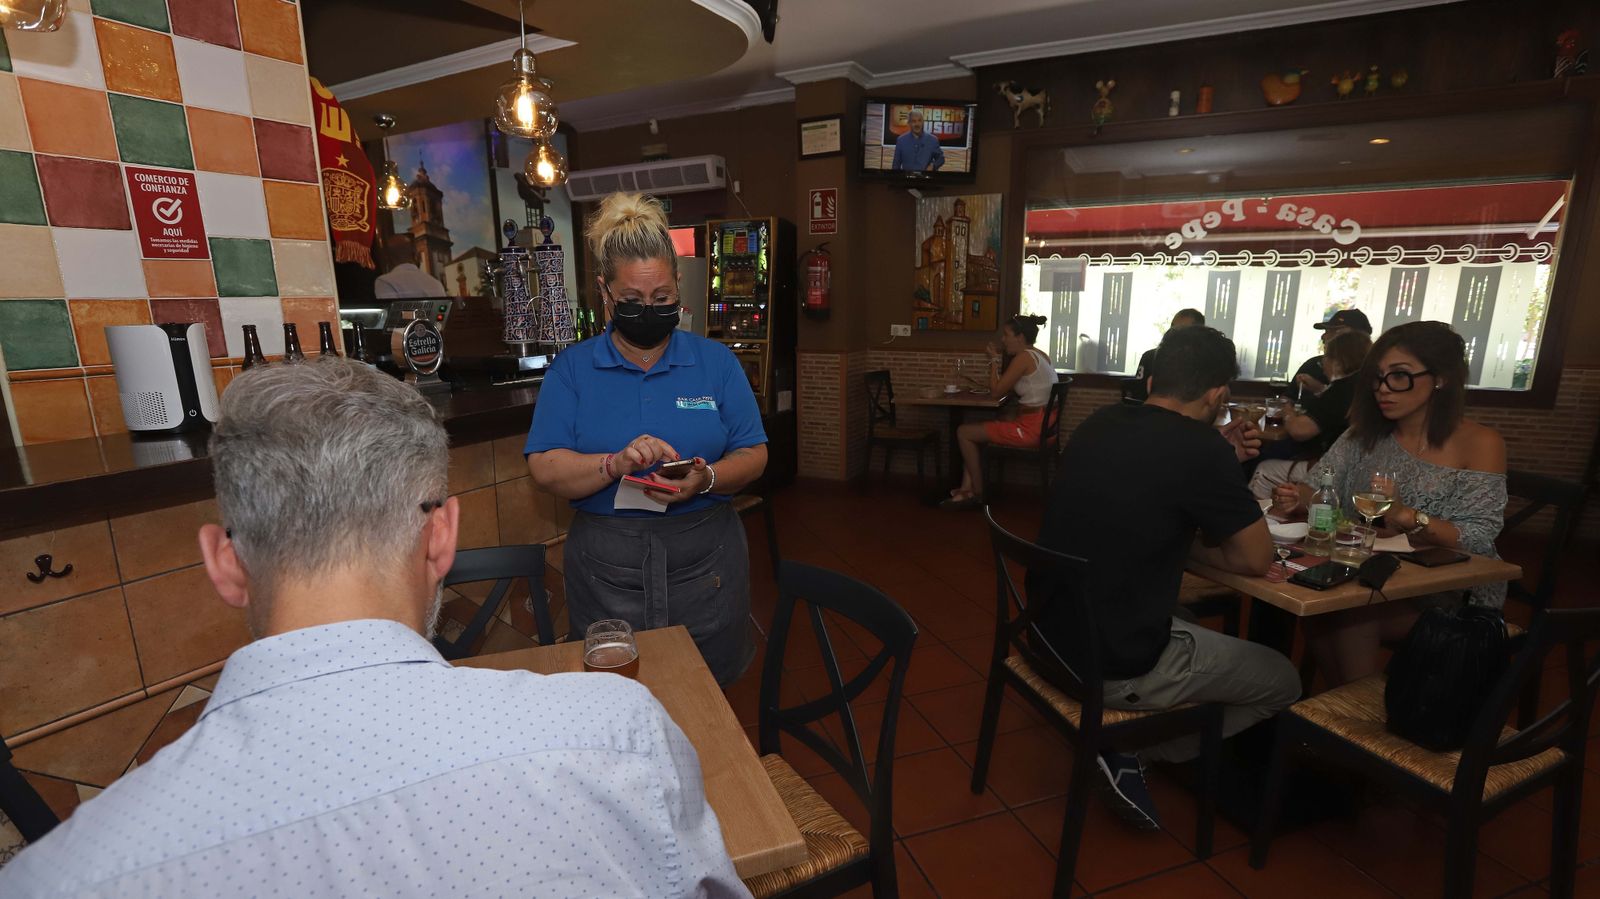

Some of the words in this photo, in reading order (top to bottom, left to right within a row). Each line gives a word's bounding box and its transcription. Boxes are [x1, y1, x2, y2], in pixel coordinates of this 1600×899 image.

[134, 173, 177, 185] COMERCIO
[178, 177, 190, 186] DE
[140, 183, 188, 195] CONFIANZA
[163, 227, 183, 237] AQUÍ
[811, 223, 836, 231] EXTINTOR
[408, 336, 436, 347] Estrella
[411, 345, 436, 355] Galicia
